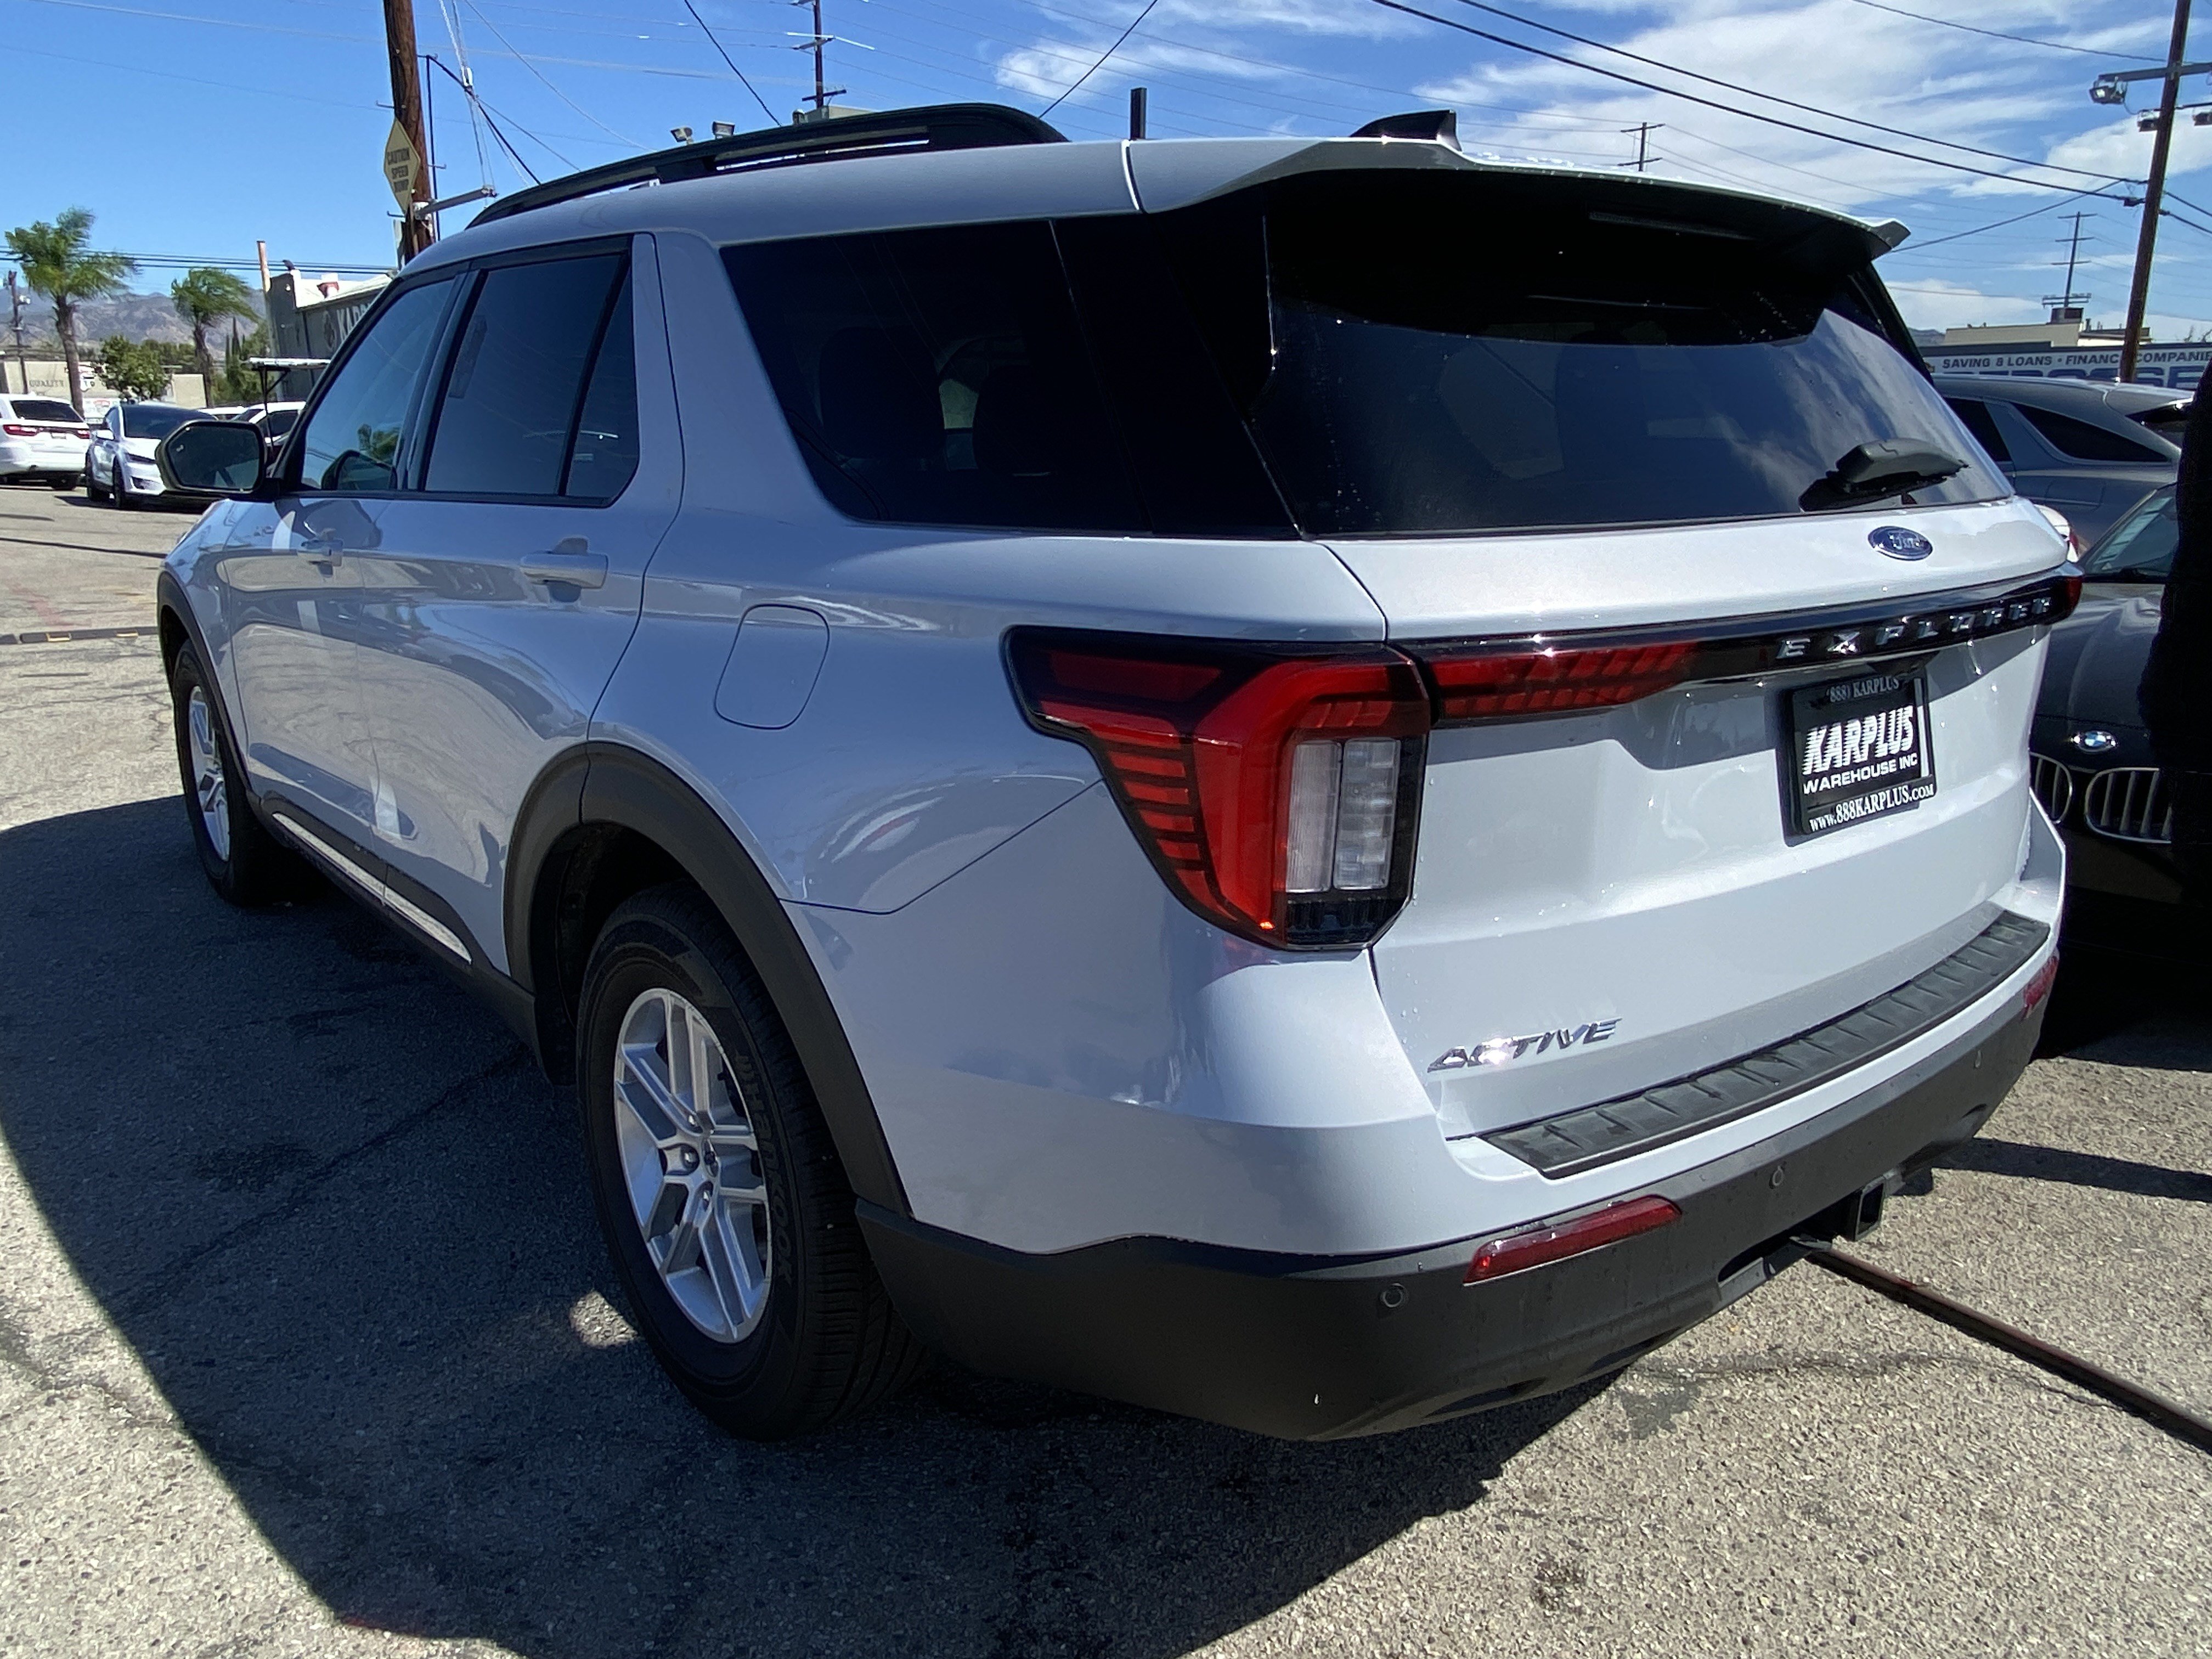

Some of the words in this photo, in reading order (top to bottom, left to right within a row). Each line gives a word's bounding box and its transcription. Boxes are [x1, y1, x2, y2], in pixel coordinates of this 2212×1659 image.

[1942, 358, 1990, 368] SAVING
[2007, 356, 2052, 366] LOANS
[2065, 354, 2119, 365] FINANC
[1776, 597, 2051, 658] EXPLORER
[1853, 675, 1900, 698] KARPLUS
[1802, 706, 1914, 775] KARPLUS
[1803, 759, 1897, 794] WAREHOUSE
[1899, 752, 1918, 769] INC
[1427, 1017, 1623, 1073] ACTIVE
